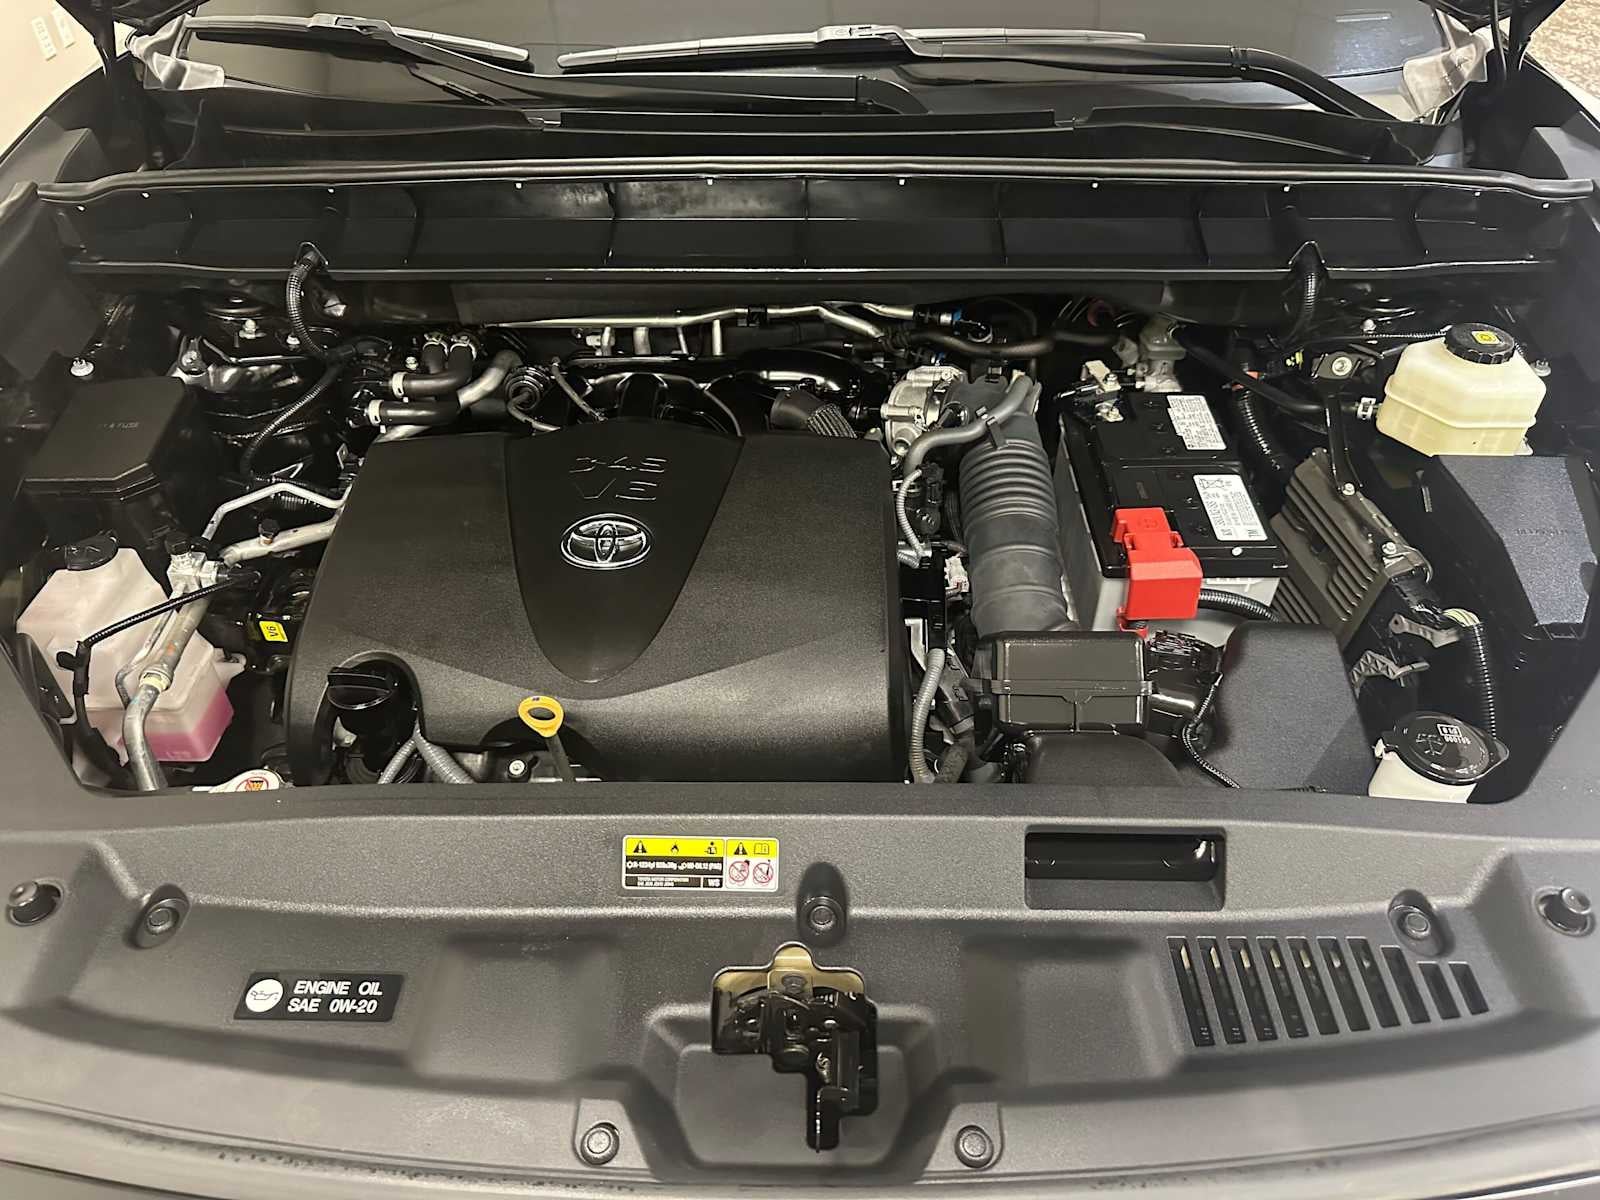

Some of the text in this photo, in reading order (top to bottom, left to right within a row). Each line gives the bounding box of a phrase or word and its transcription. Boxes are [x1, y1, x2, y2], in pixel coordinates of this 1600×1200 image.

[266, 626, 278, 636] V6
[293, 980, 383, 996] ENGINE OIL
[287, 998, 378, 1014] SAE 0W-20
